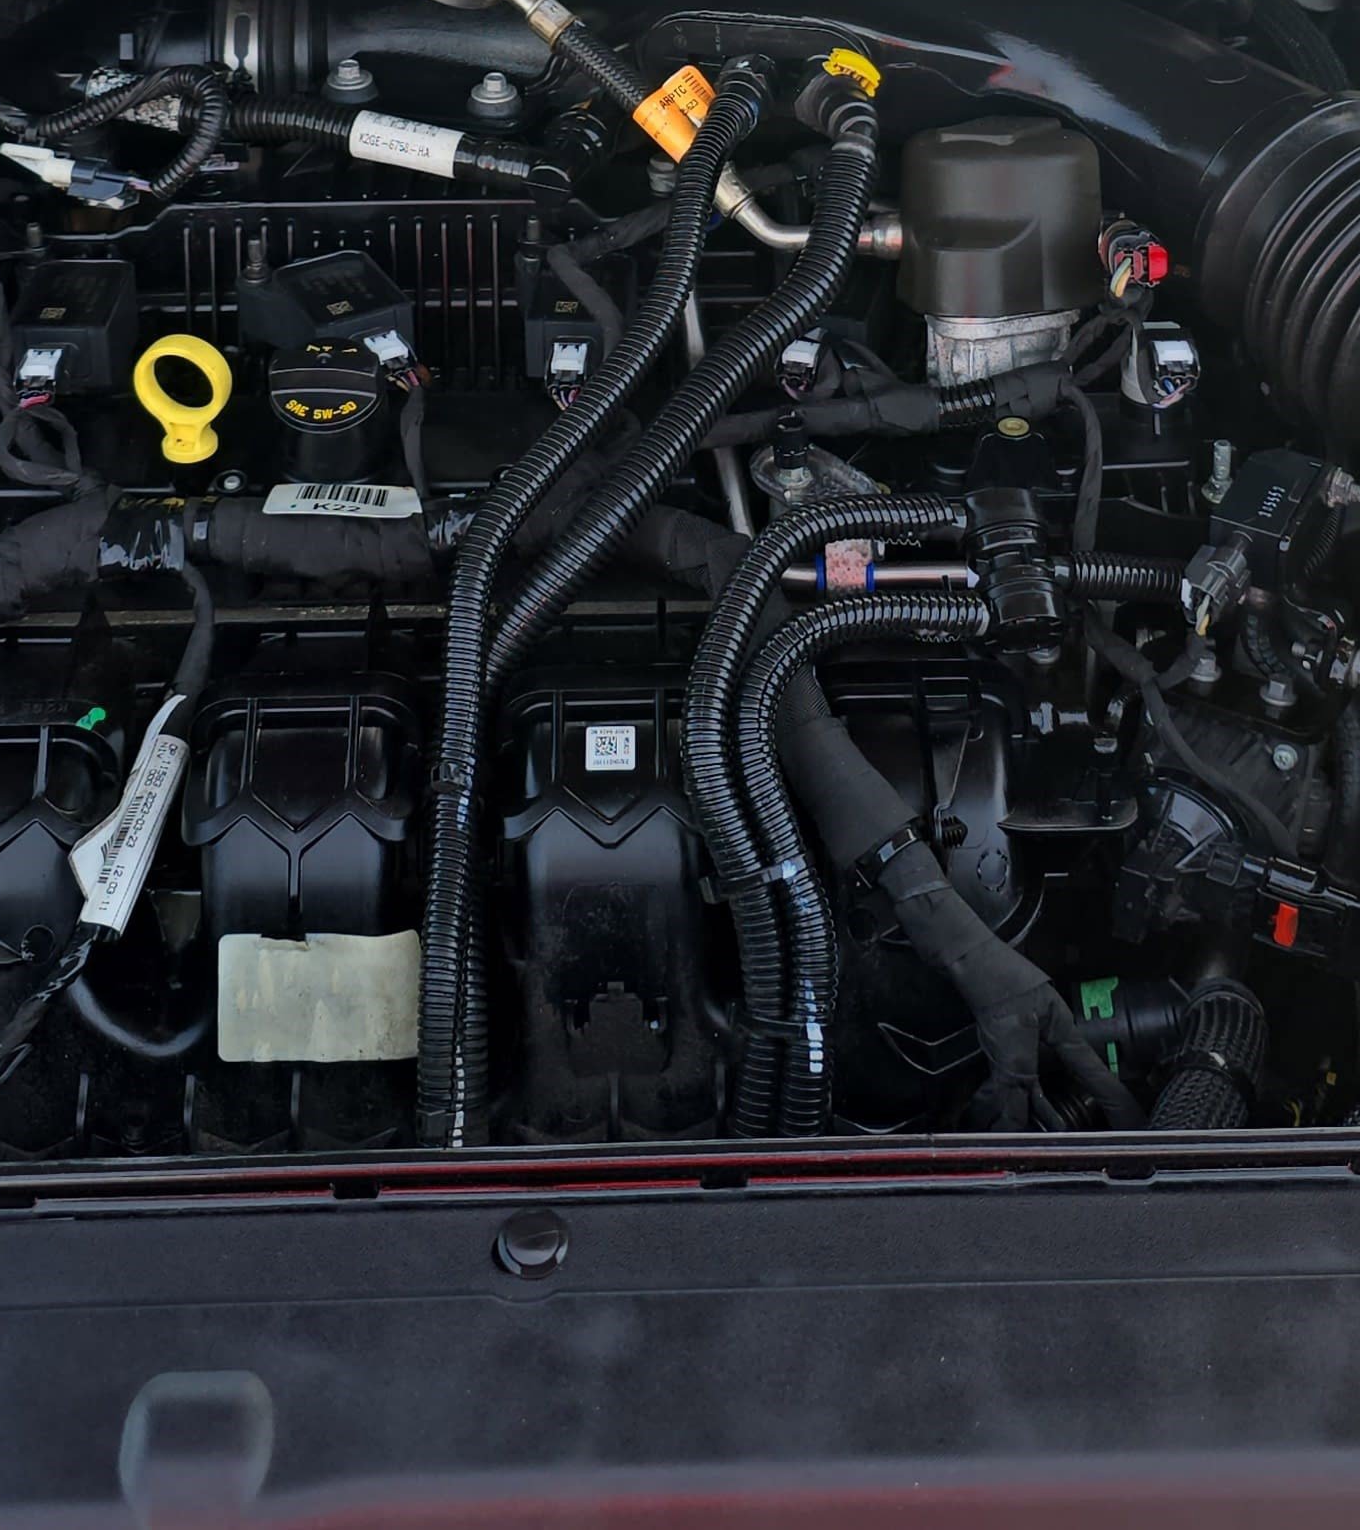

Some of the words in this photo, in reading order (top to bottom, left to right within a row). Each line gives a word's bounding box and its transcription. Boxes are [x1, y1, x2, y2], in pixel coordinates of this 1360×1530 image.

[285, 399, 310, 418] SAE
[313, 401, 358, 420] 5W-30
[312, 502, 362, 513] K22
[125, 791, 158, 849] 2023-03-23
